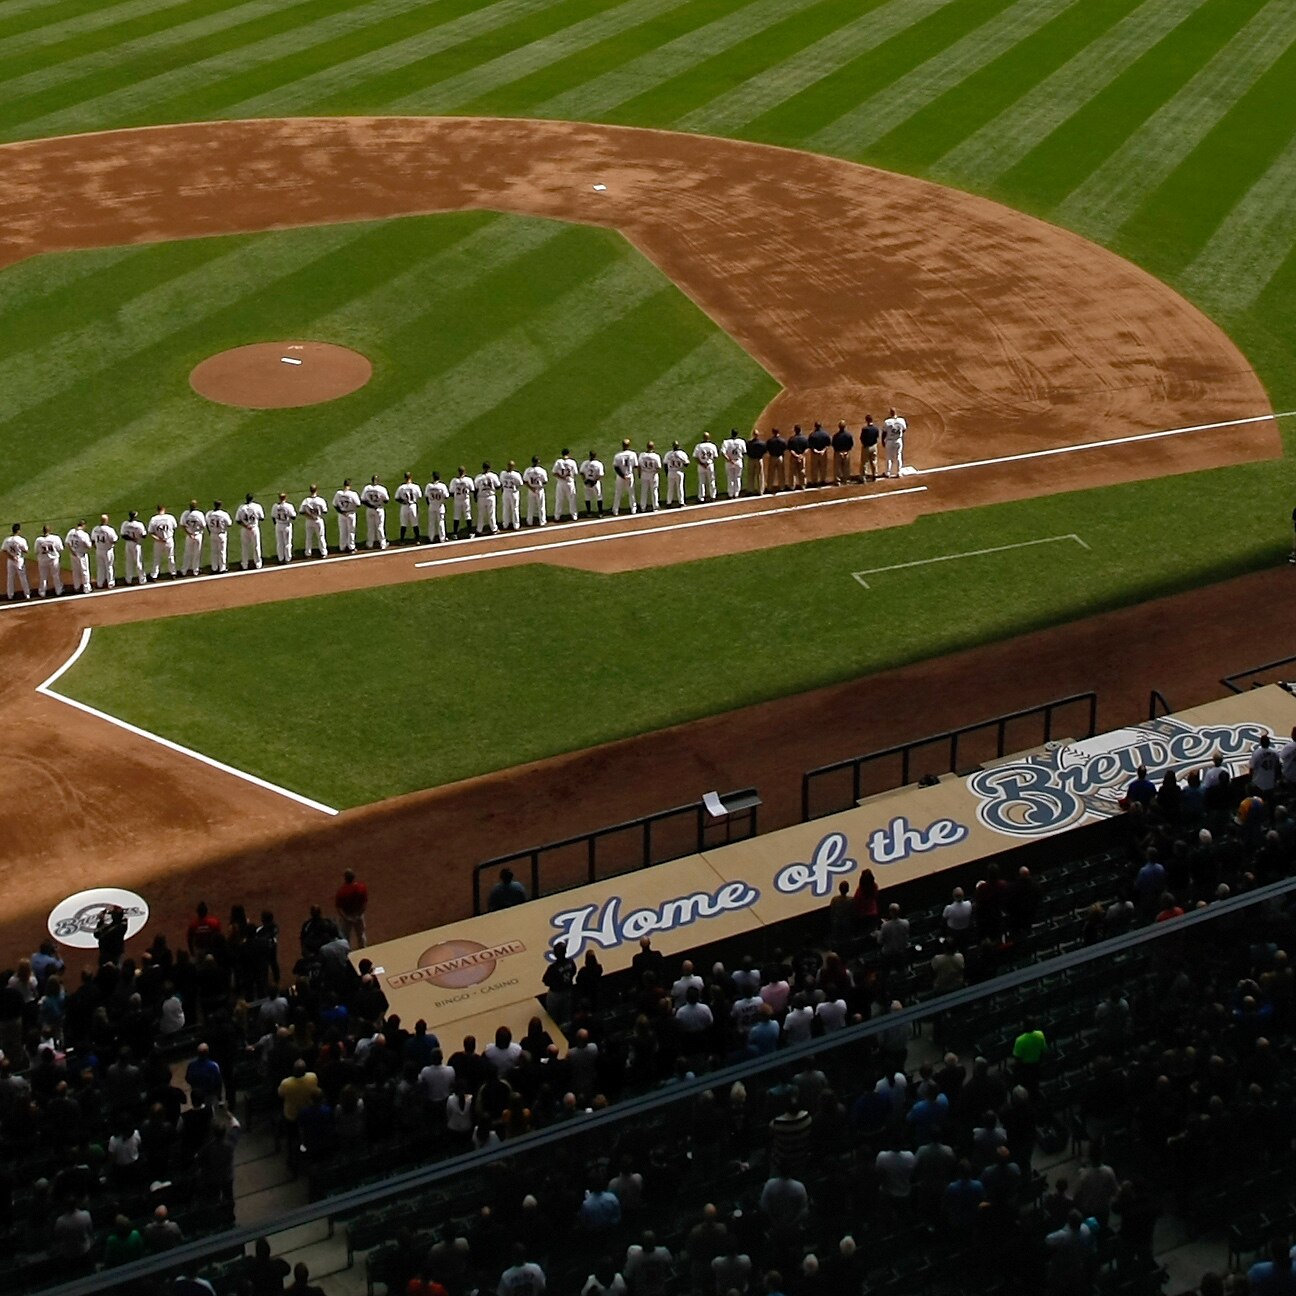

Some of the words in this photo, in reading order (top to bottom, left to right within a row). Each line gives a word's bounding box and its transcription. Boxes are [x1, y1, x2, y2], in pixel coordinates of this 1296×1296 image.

[965, 719, 1278, 839] Brewers
[544, 879, 760, 964] Home
[773, 830, 858, 896] of
[865, 815, 969, 866] the
[398, 943, 519, 984] POTAWATOMI
[434, 994, 471, 1009] BINGO
[479, 977, 520, 995] CASINO
